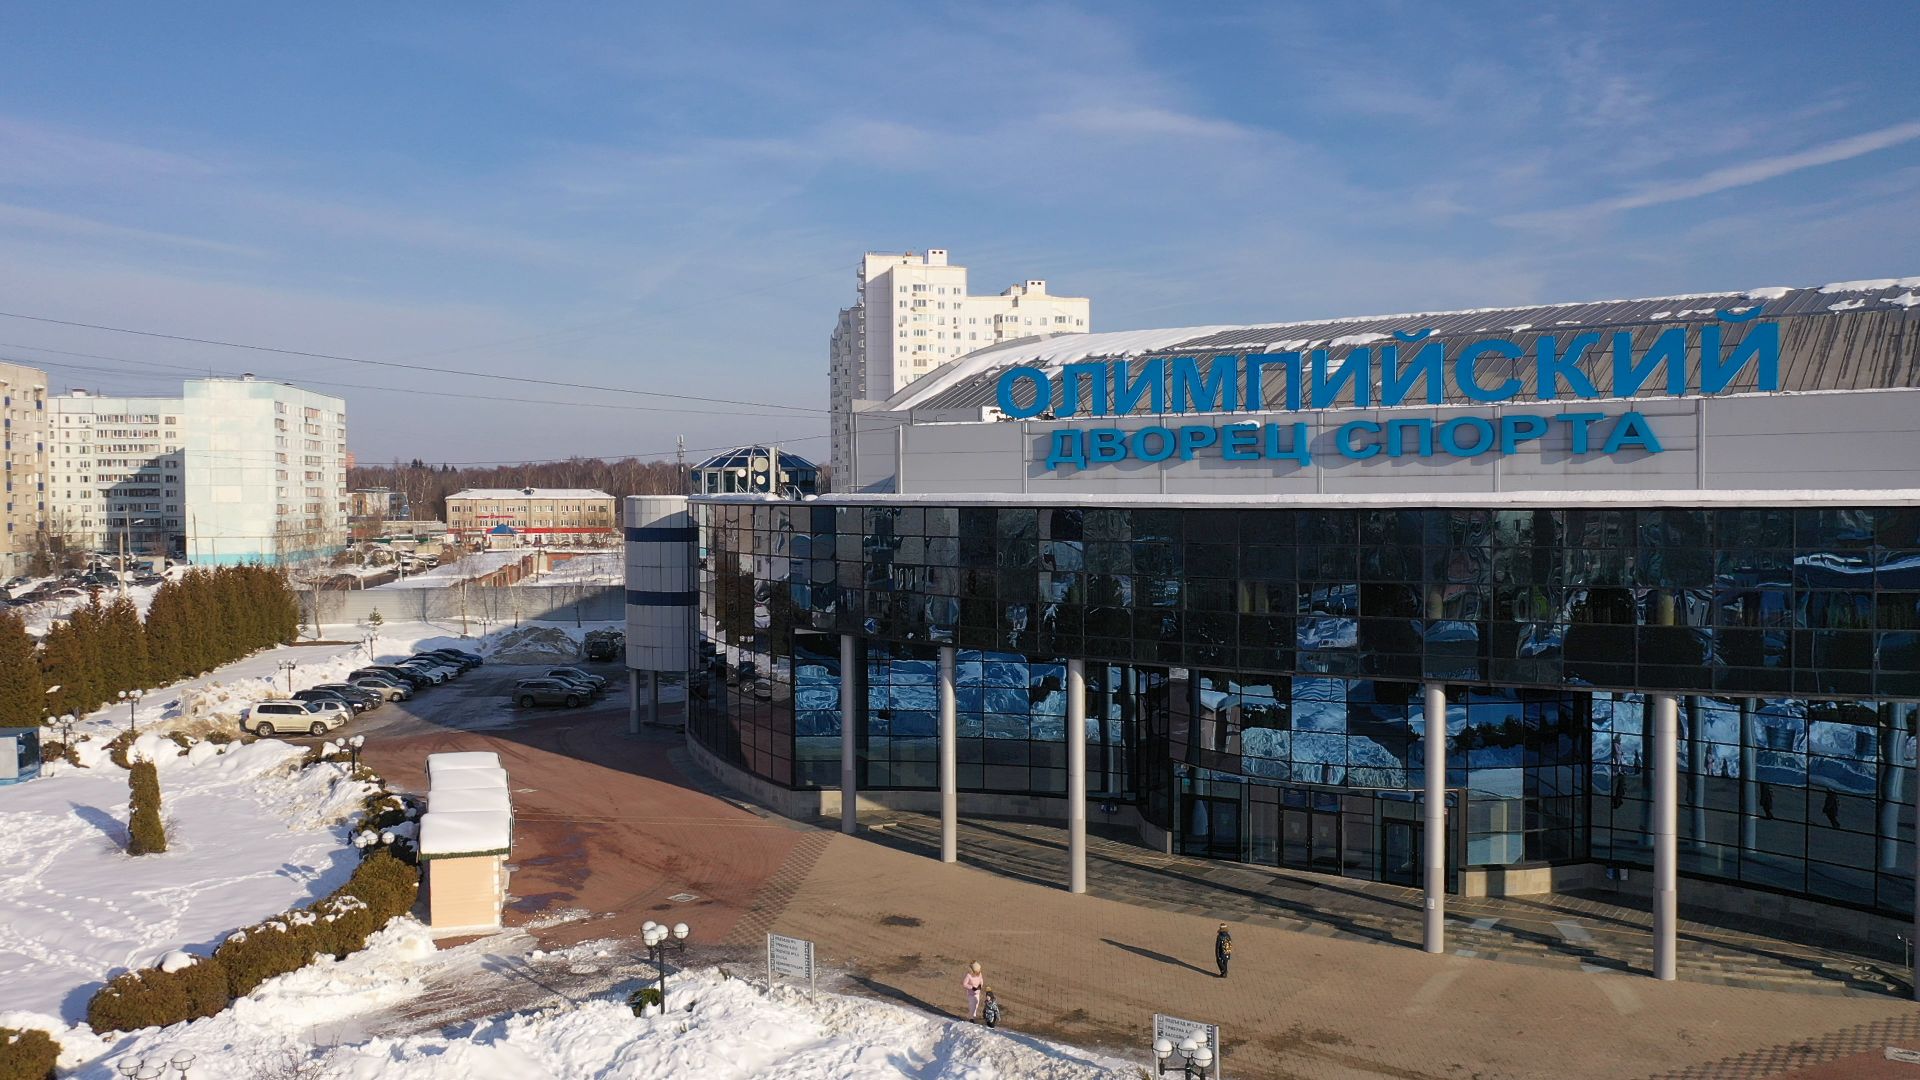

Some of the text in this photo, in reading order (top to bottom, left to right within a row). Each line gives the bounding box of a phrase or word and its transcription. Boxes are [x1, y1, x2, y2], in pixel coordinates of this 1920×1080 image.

[997, 306, 1779, 418] ОЛИМПИЙСКИЙ
[1046, 412, 1663, 470] ДВОРЕЦ СПОРТА
